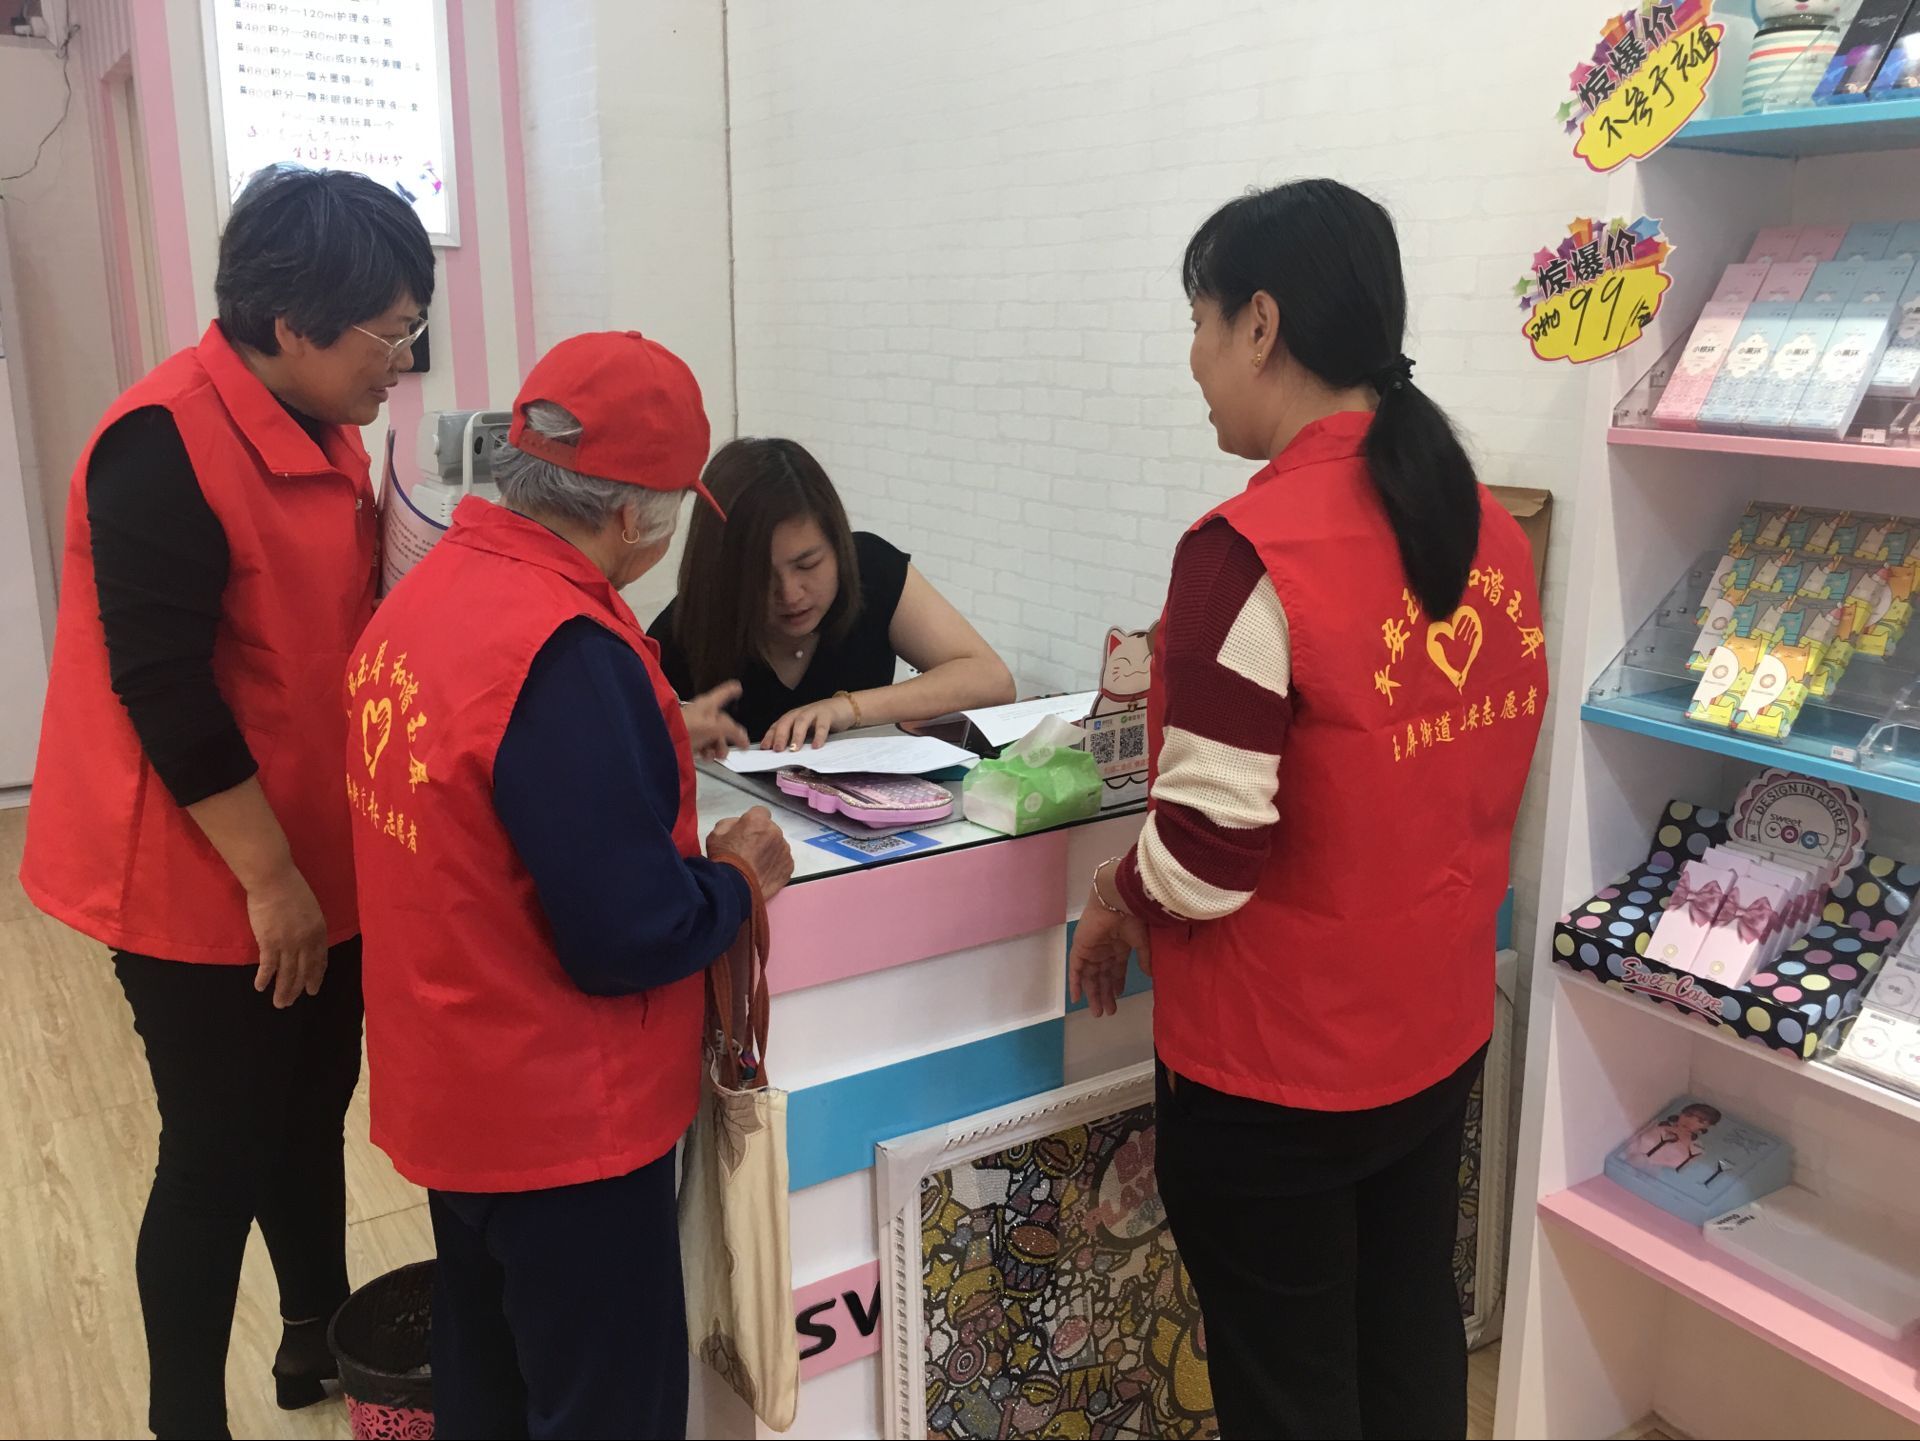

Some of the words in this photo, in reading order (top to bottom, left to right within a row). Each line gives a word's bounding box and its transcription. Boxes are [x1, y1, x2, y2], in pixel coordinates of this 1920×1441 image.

[1577, 4, 1679, 117] 惊爆价
[1538, 226, 1638, 302] 惊爆价
[1754, 783, 1798, 816] DESIGN
[1801, 785, 1815, 796] IN
[1817, 790, 1847, 836] KOREA
